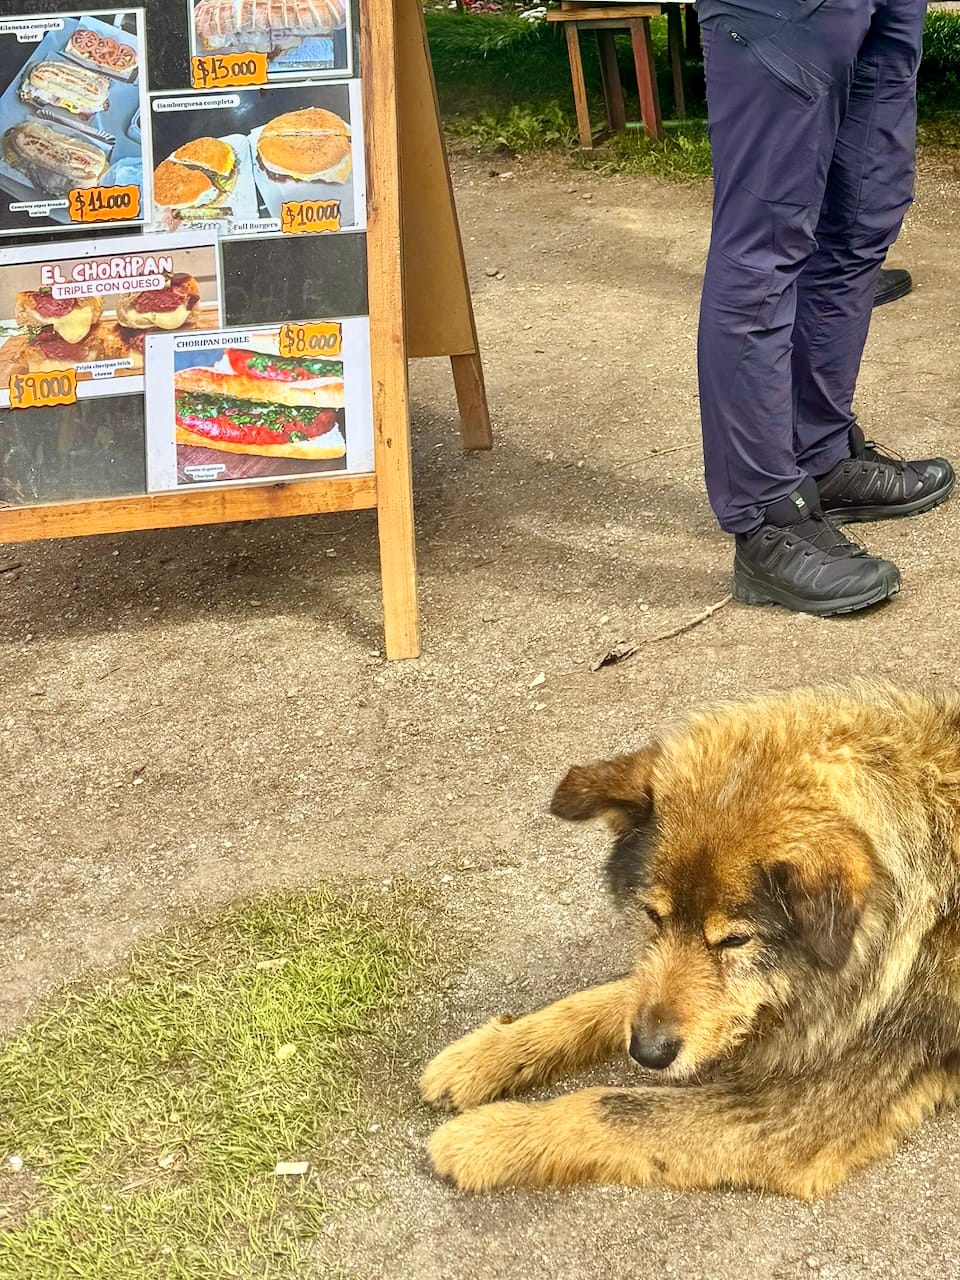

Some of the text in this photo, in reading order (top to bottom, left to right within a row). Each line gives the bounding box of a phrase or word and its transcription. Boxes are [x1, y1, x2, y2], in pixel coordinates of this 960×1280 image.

[203, 98, 234, 107] completa
[41, 265, 66, 285] EL
[57, 278, 161, 297] TRIPLE CON QUESO
[176, 336, 250, 348] CHORIPAN DOBLE
